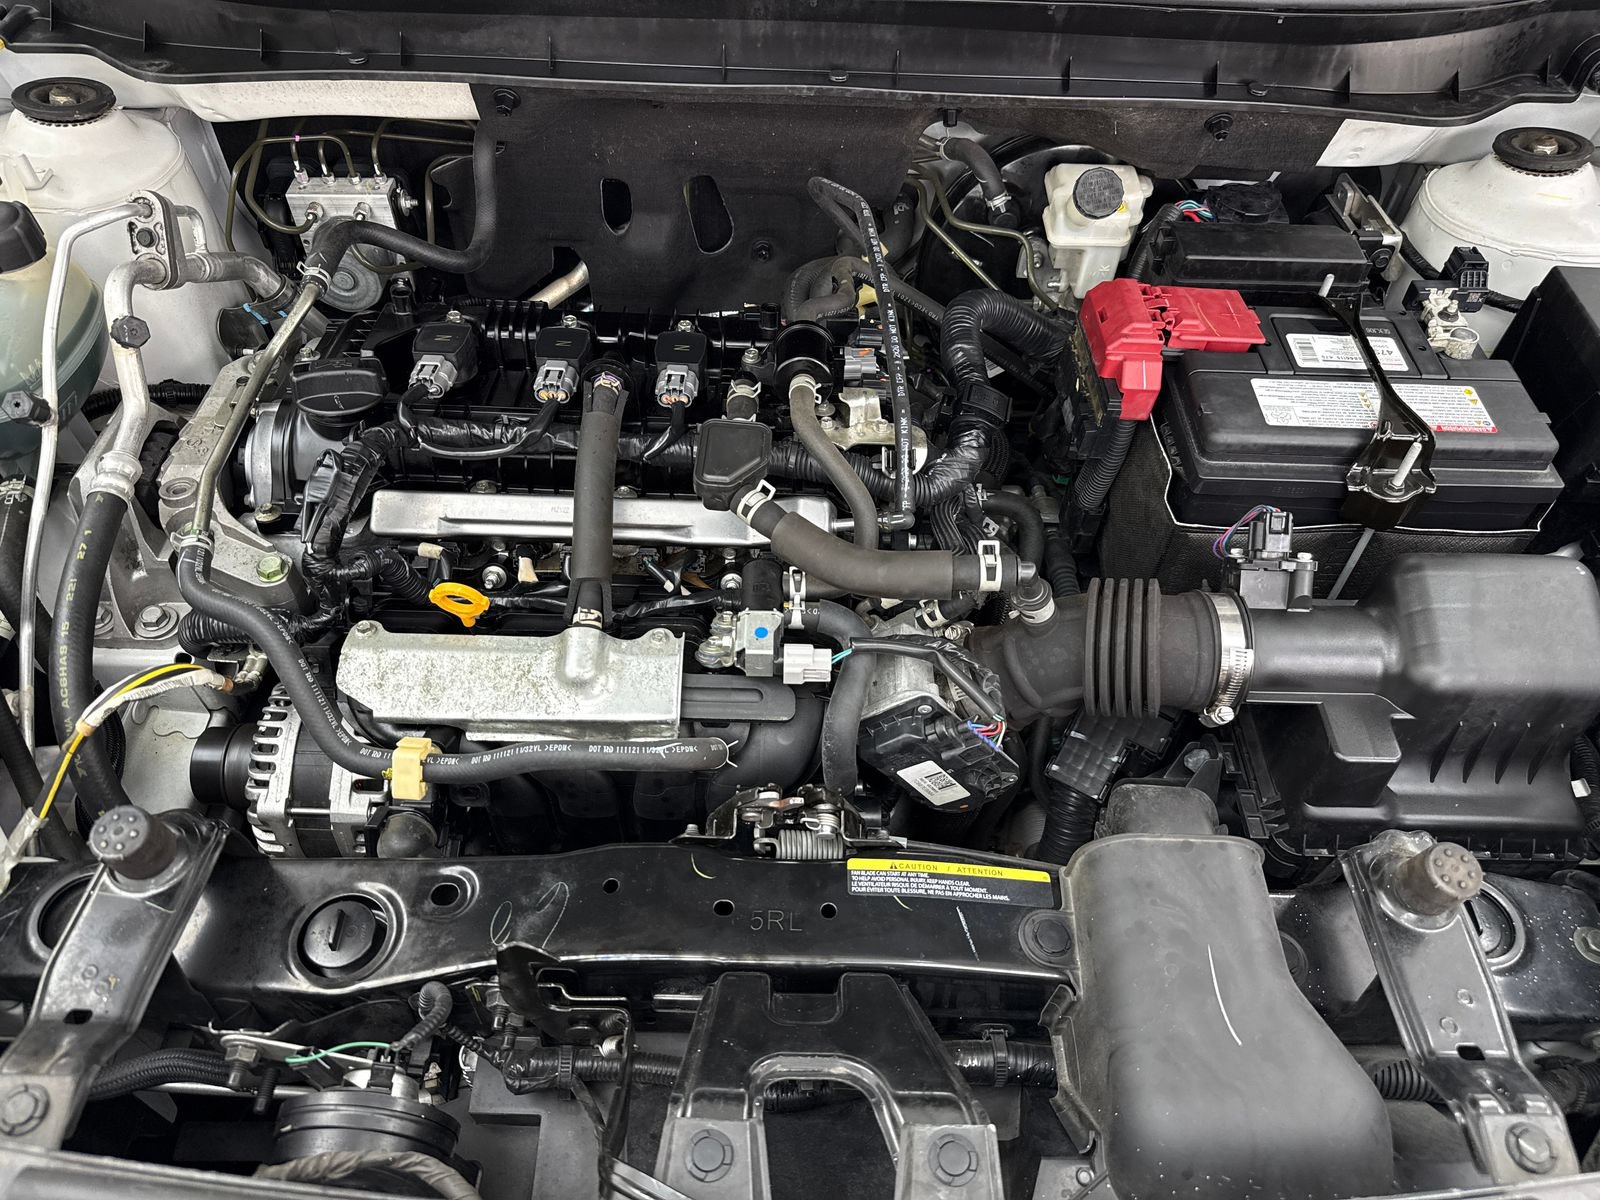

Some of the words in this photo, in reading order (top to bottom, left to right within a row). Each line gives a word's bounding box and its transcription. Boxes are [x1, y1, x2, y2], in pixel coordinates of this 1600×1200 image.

[887, 309, 896, 322] KINK
[889, 322, 898, 334] NOT
[900, 416, 909, 435] KINK
[61, 621, 70, 638] 15
[76, 543, 88, 560] 27
[493, 749, 514, 760] 111121
[588, 744, 602, 753] DOT
[616, 745, 640, 754] 111121
[899, 863, 938, 871] CAUTION
[956, 867, 1003, 876] ATTENTION
[750, 909, 803, 931] 5RL
